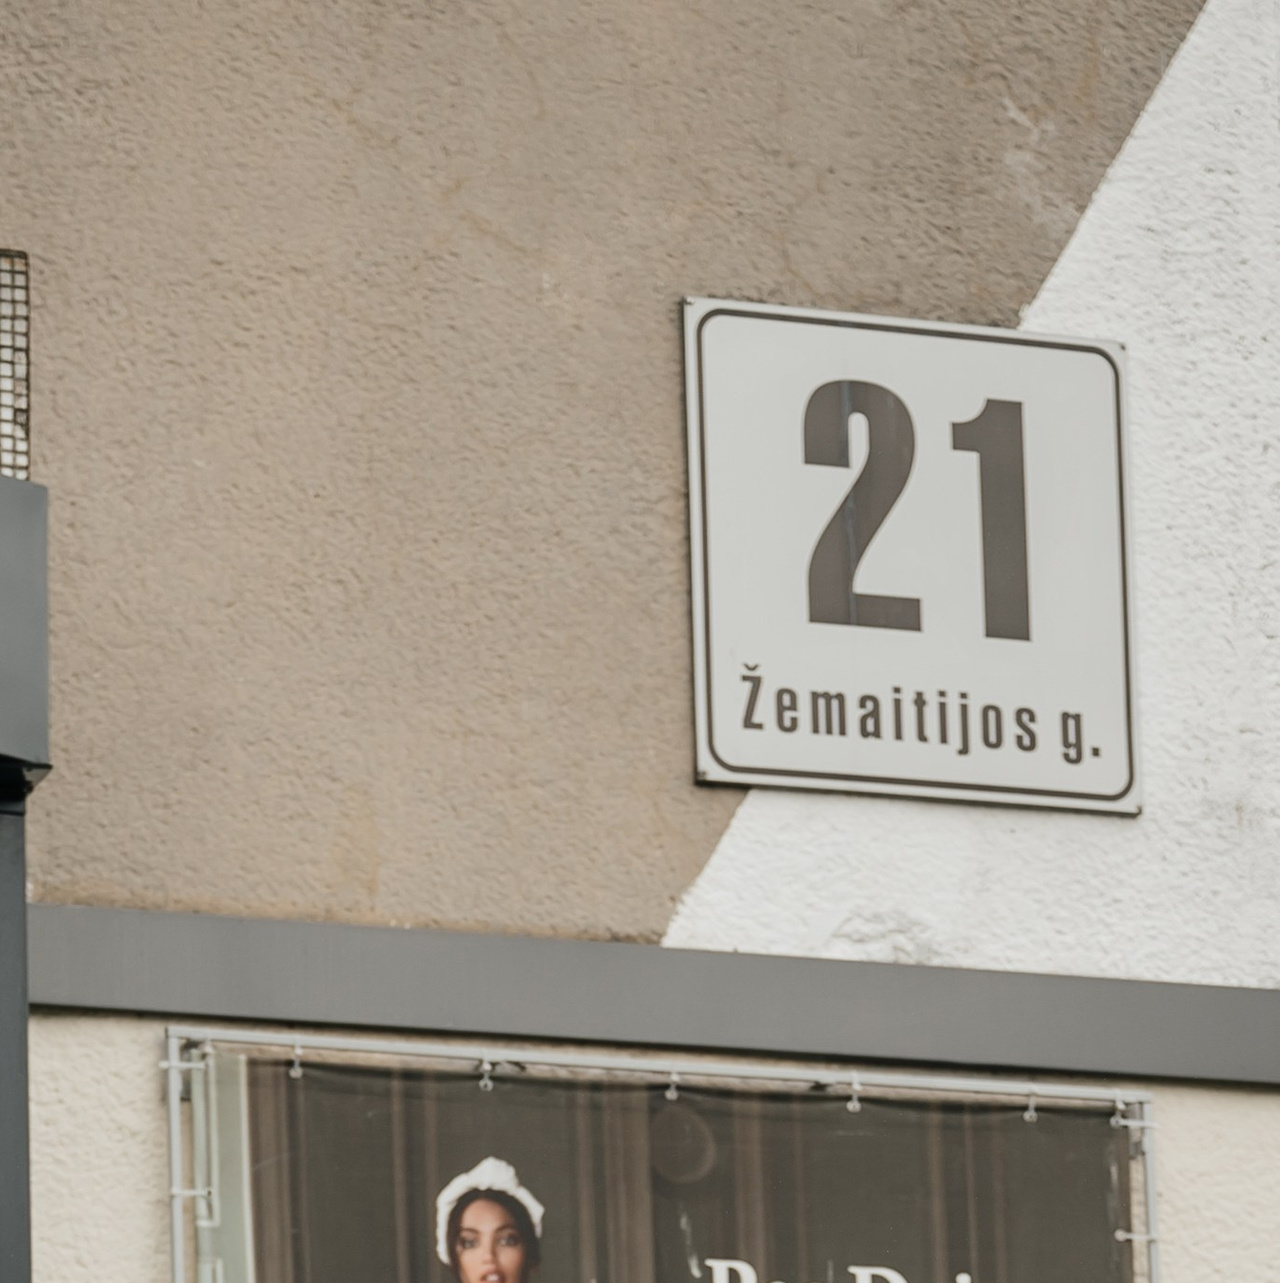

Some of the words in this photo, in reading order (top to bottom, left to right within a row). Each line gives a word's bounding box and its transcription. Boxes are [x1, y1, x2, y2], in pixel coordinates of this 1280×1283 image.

[803, 379, 1032, 642] 21
[740, 663, 1038, 757] Žemaitijos
[1060, 711, 1102, 765] g.
